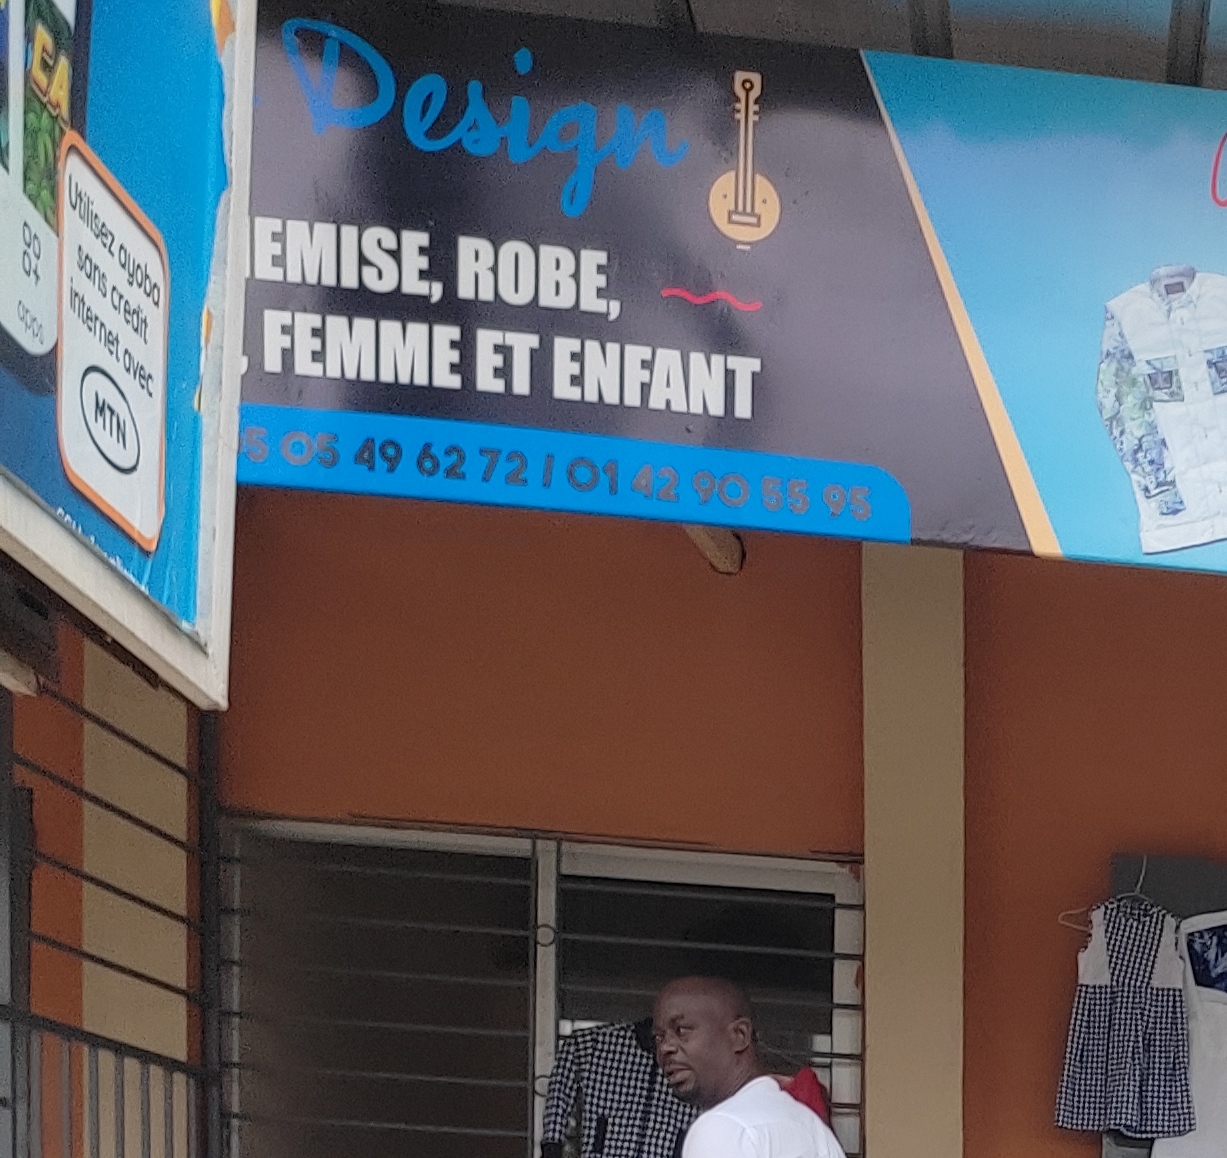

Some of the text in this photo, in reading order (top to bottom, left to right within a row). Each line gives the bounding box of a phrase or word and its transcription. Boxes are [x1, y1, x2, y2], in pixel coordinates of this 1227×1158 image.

[281, 17, 688, 218] Design
[68, 172, 161, 310] Utilisez ayoba
[77, 244, 149, 345] sans credit
[246, 216, 622, 322] EMISE, ROBE,
[69, 276, 155, 399] internet avec
[263, 309, 762, 420] FEMME ET ENFANT
[94, 390, 127, 451] MTN
[281, 430, 340, 468] 05
[354, 437, 403, 473] 49
[416, 441, 466, 481] 62
[479, 447, 528, 487] 72
[566, 456, 618, 496] 01
[632, 463, 680, 502] 42
[692, 469, 750, 509] 90
[761, 475, 811, 515] 55
[822, 484, 873, 522] 95
